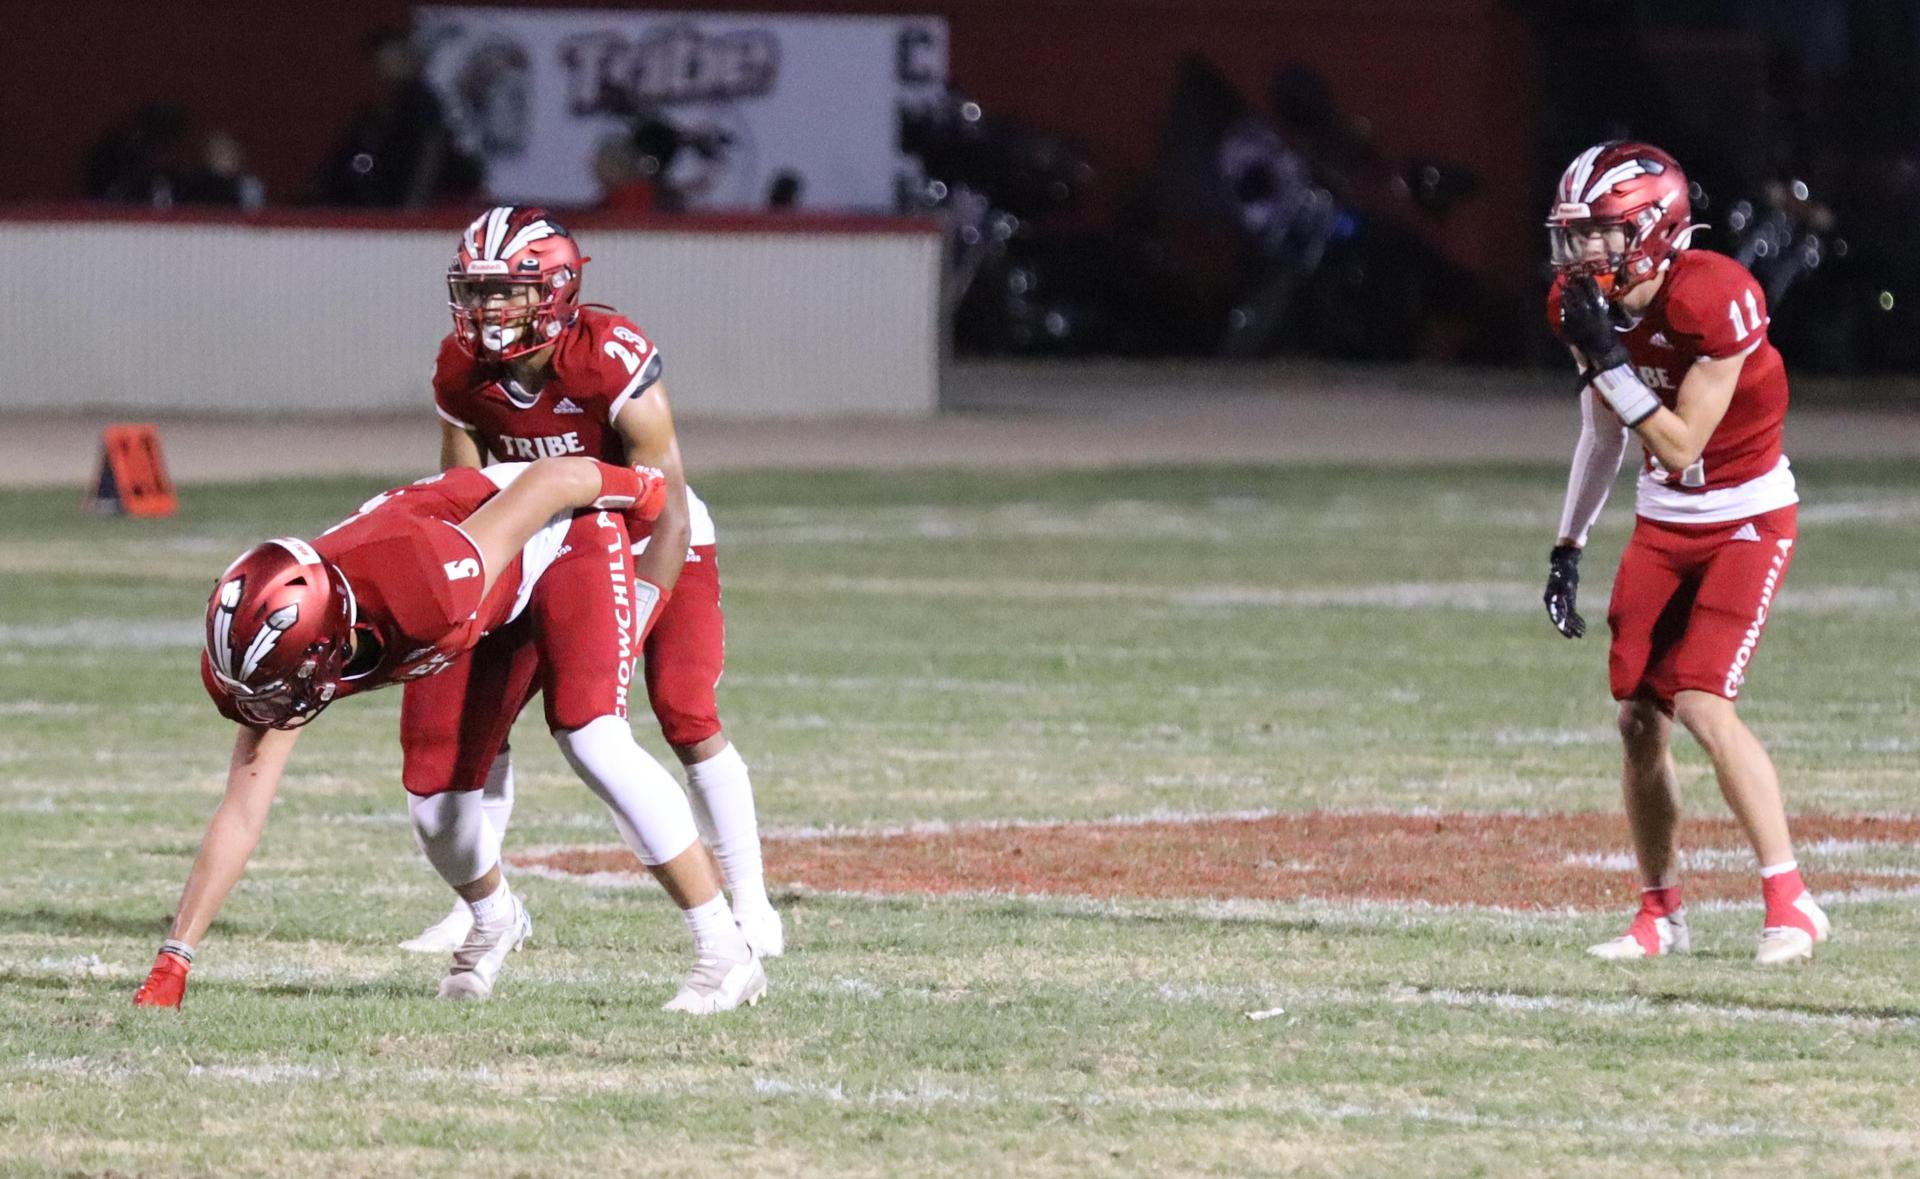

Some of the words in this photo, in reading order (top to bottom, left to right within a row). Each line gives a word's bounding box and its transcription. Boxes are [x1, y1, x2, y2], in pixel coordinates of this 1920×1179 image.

[1728, 288, 1762, 342] 11
[603, 325, 648, 376] 23
[499, 431, 585, 460] TRIBE
[442, 557, 481, 581] 5
[1724, 538, 1793, 698] CHOWCHILLA
